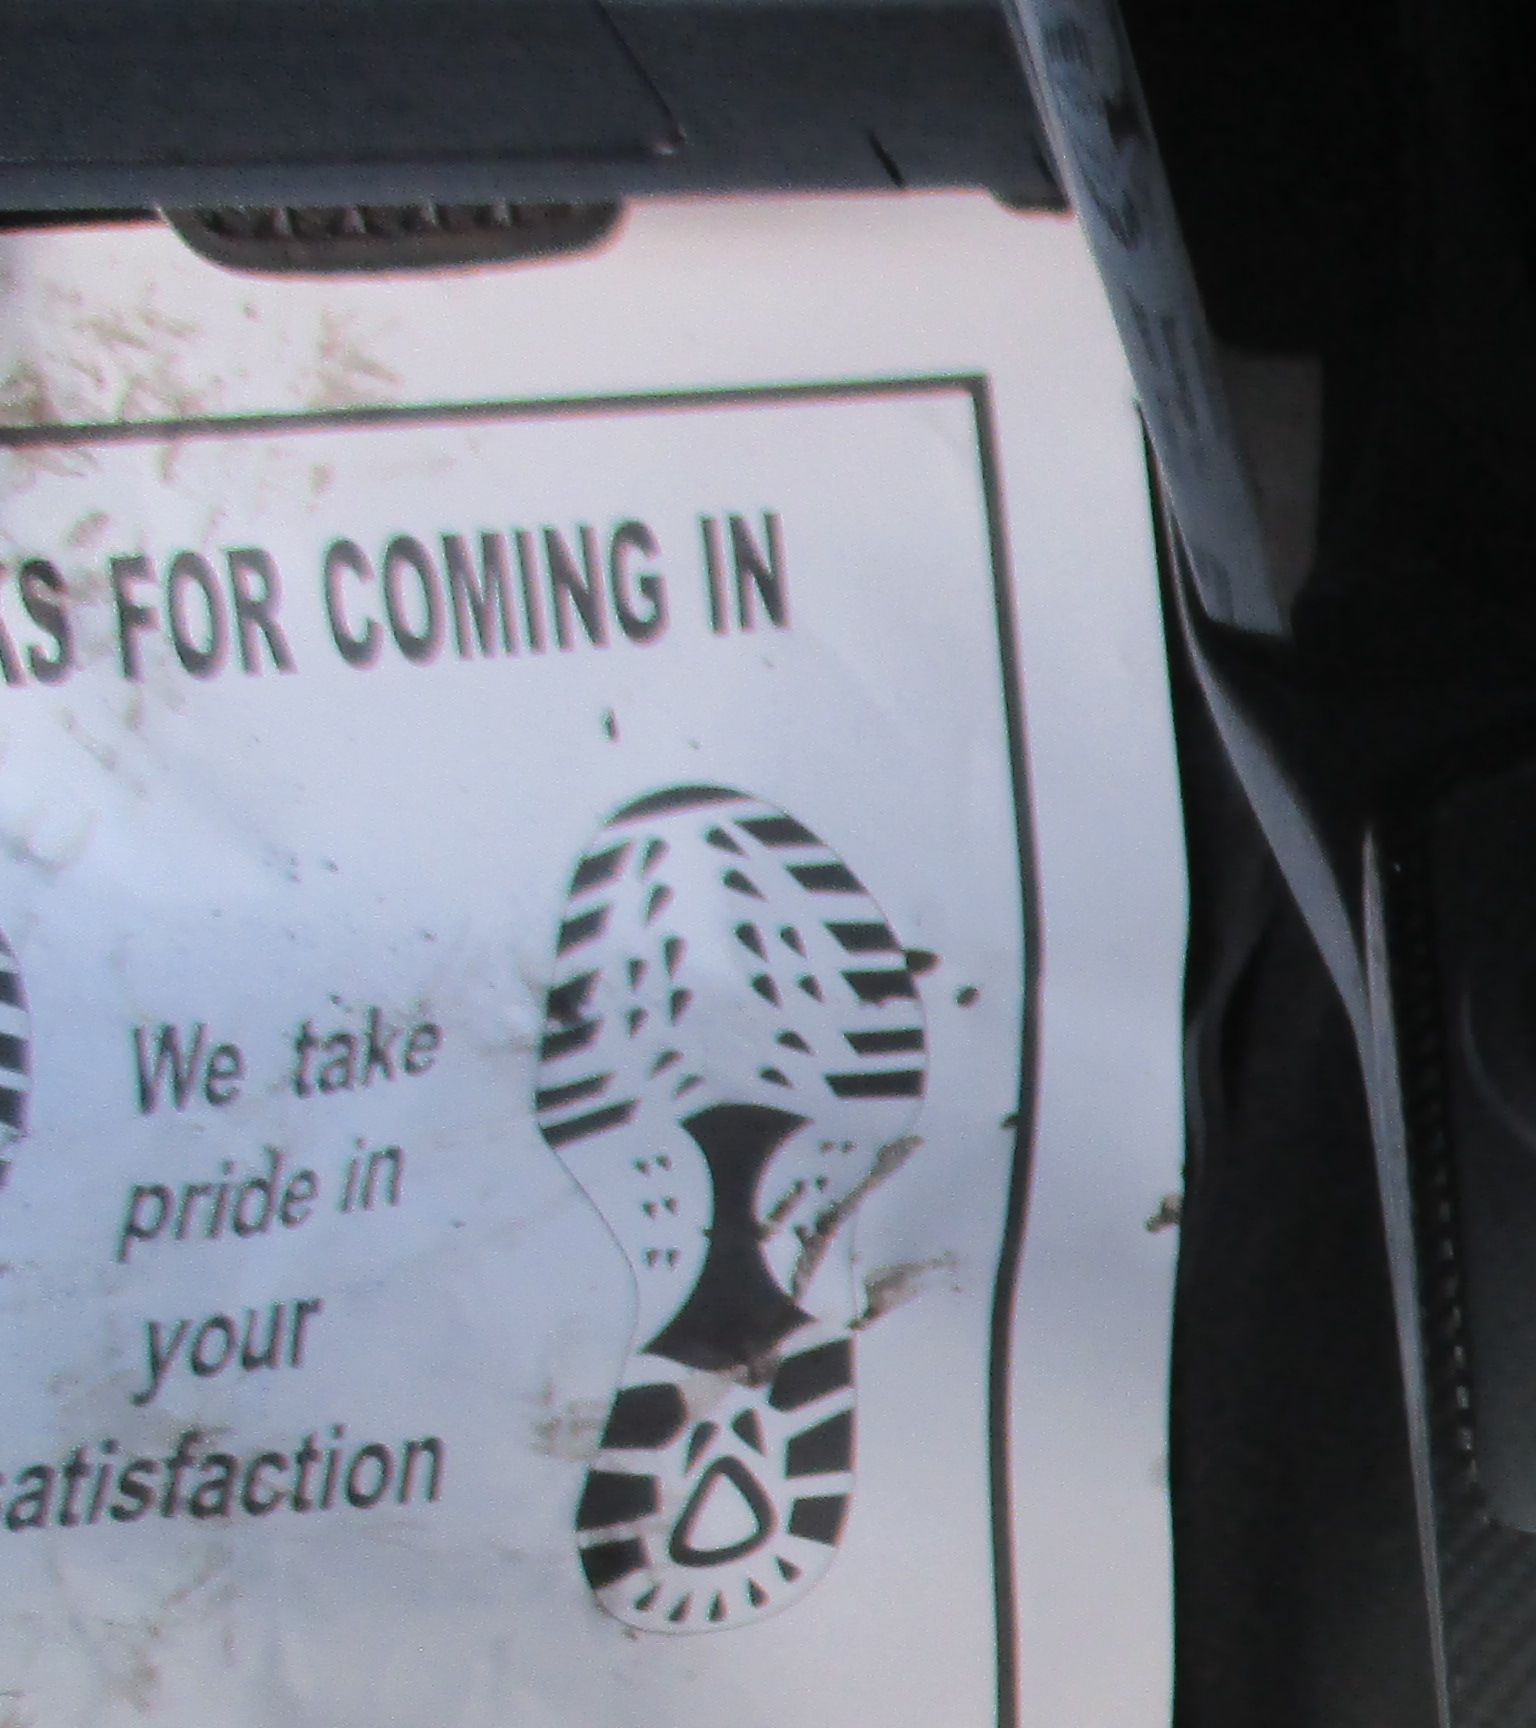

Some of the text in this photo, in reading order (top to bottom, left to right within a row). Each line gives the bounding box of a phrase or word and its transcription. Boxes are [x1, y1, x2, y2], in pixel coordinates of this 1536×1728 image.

[109, 548, 298, 681] FOR
[324, 518, 668, 670] COMING
[699, 511, 790, 635] IN
[132, 1006, 443, 1116] We take
[116, 1137, 406, 1263] pride in
[131, 1297, 324, 1407] your
[0, 1424, 446, 1532] atisfaction
